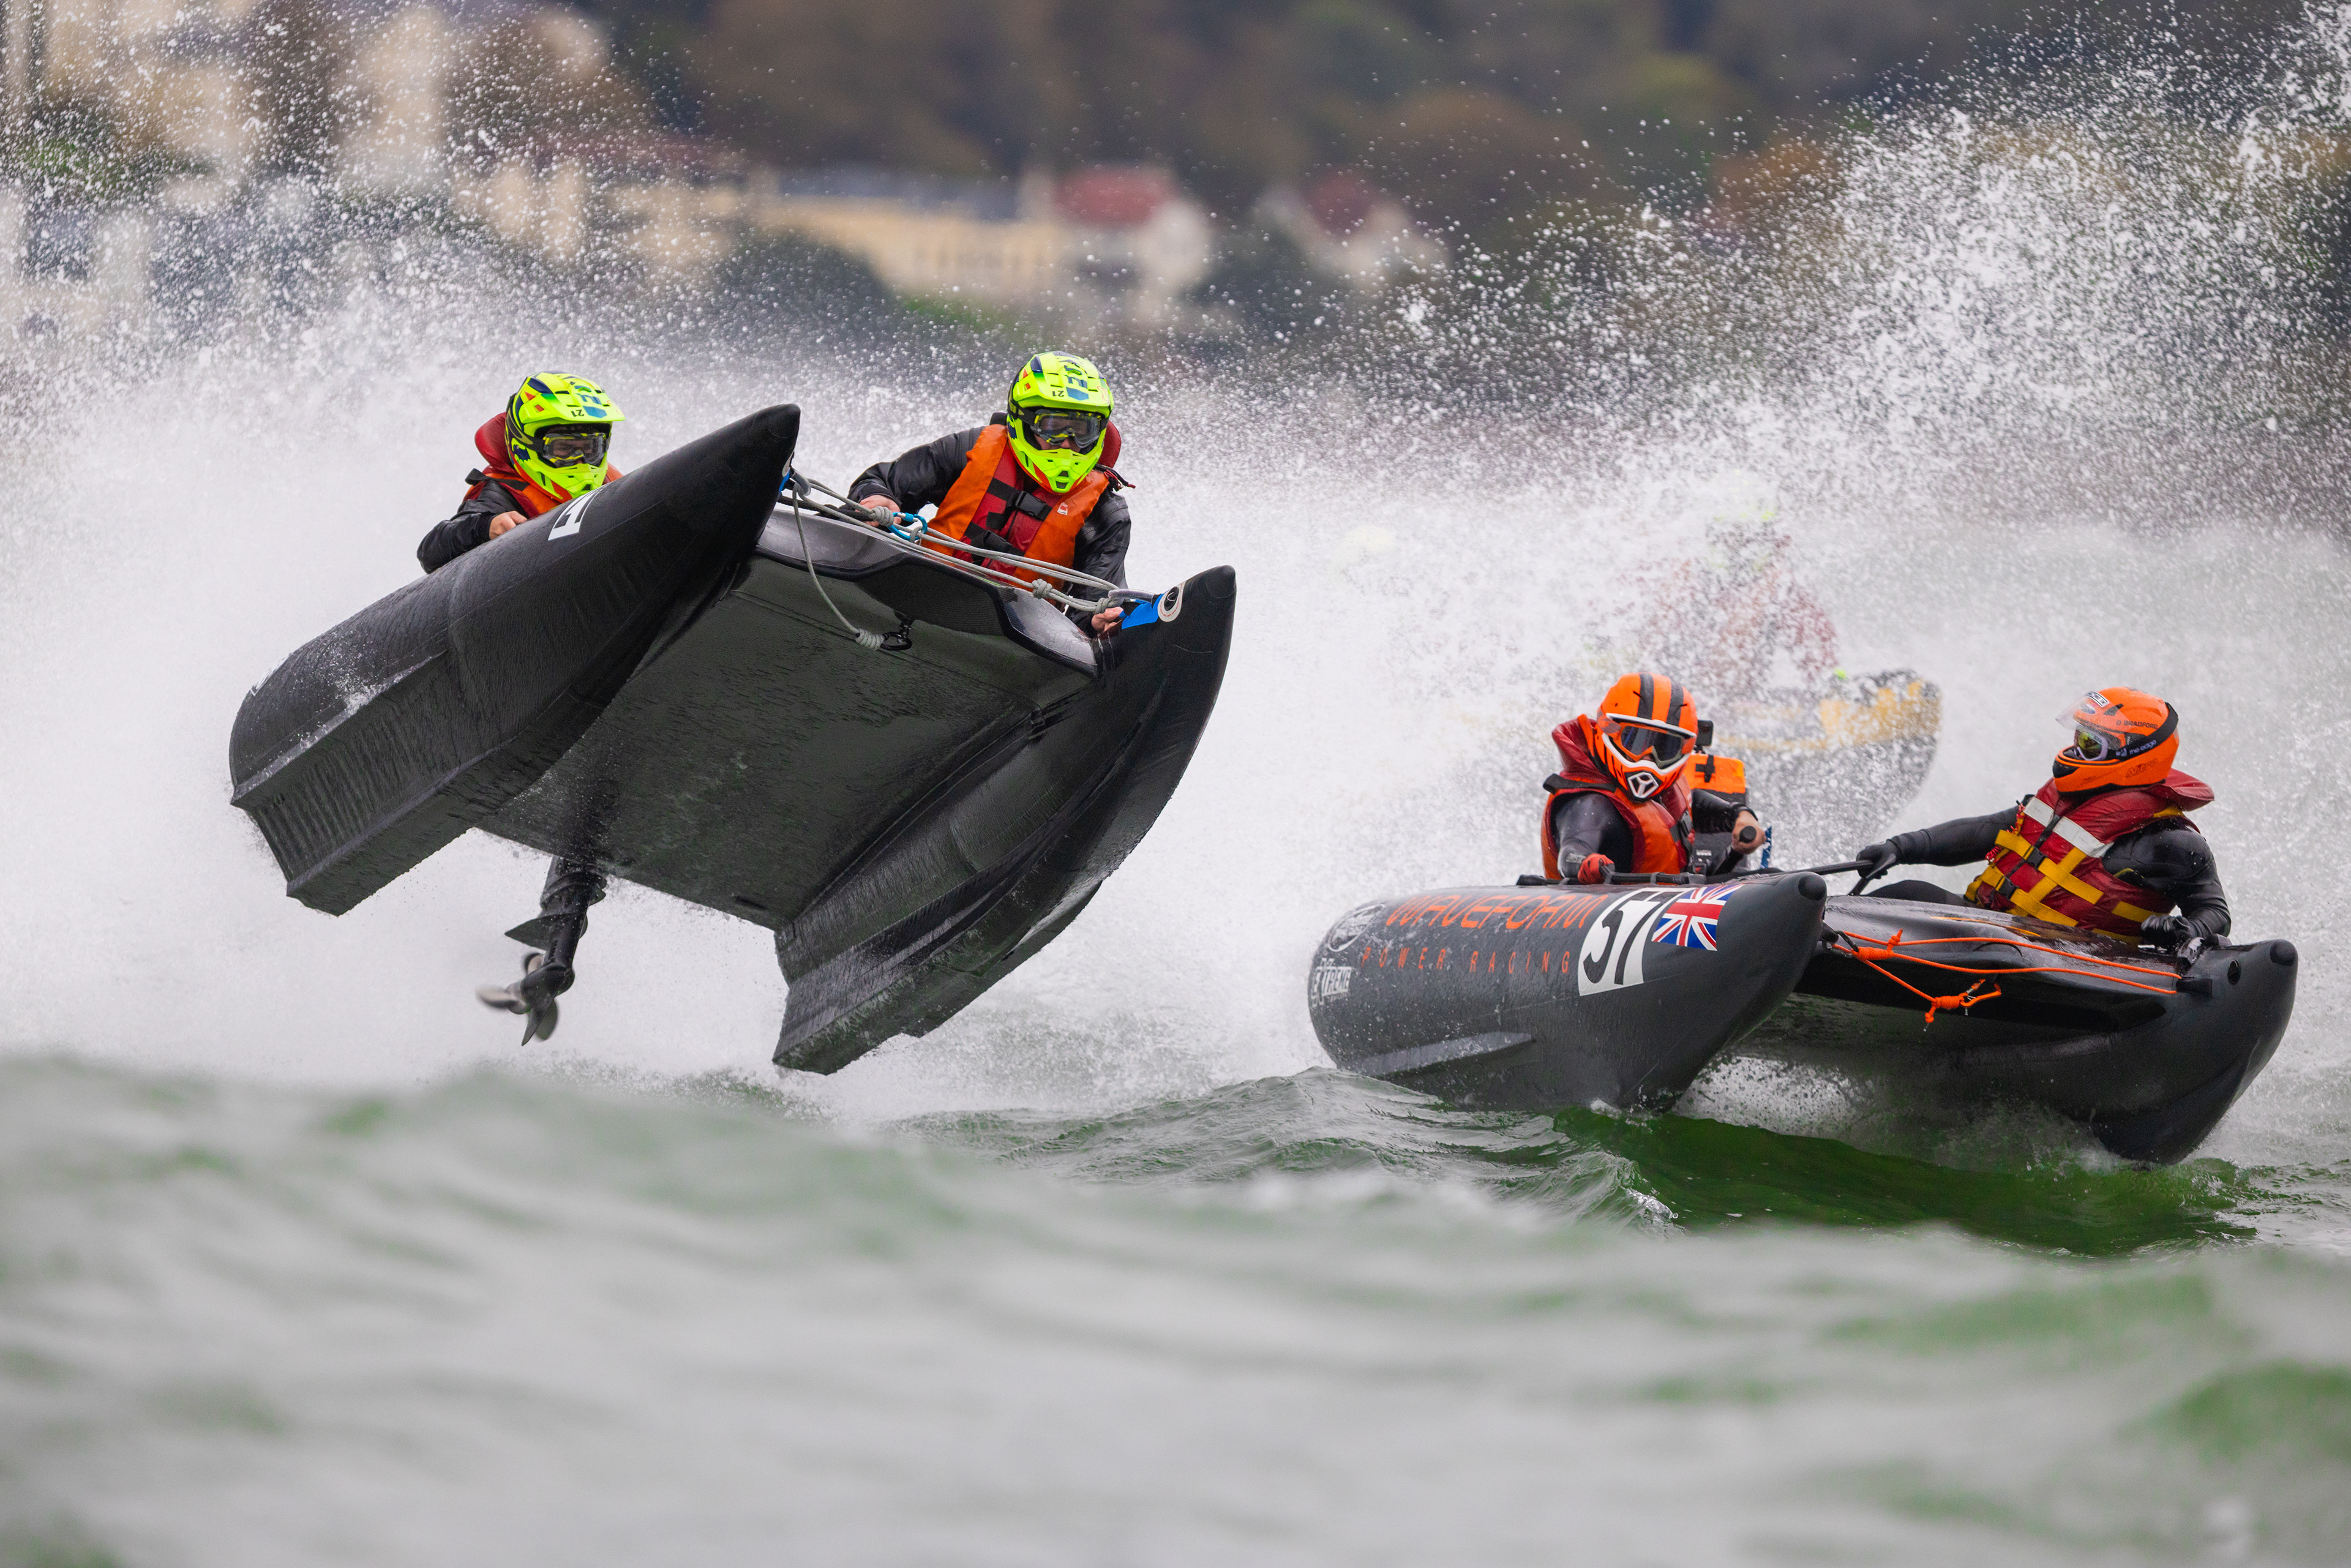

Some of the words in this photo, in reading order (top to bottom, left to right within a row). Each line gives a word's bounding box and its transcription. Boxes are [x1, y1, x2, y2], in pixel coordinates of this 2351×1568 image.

[2124, 720, 2158, 729] BRADFORD
[1385, 894, 1608, 930] WAVEFOAM
[1583, 891, 1686, 986] 57
[1360, 947, 1446, 969] POWER
[1469, 951, 1570, 973] RACING
